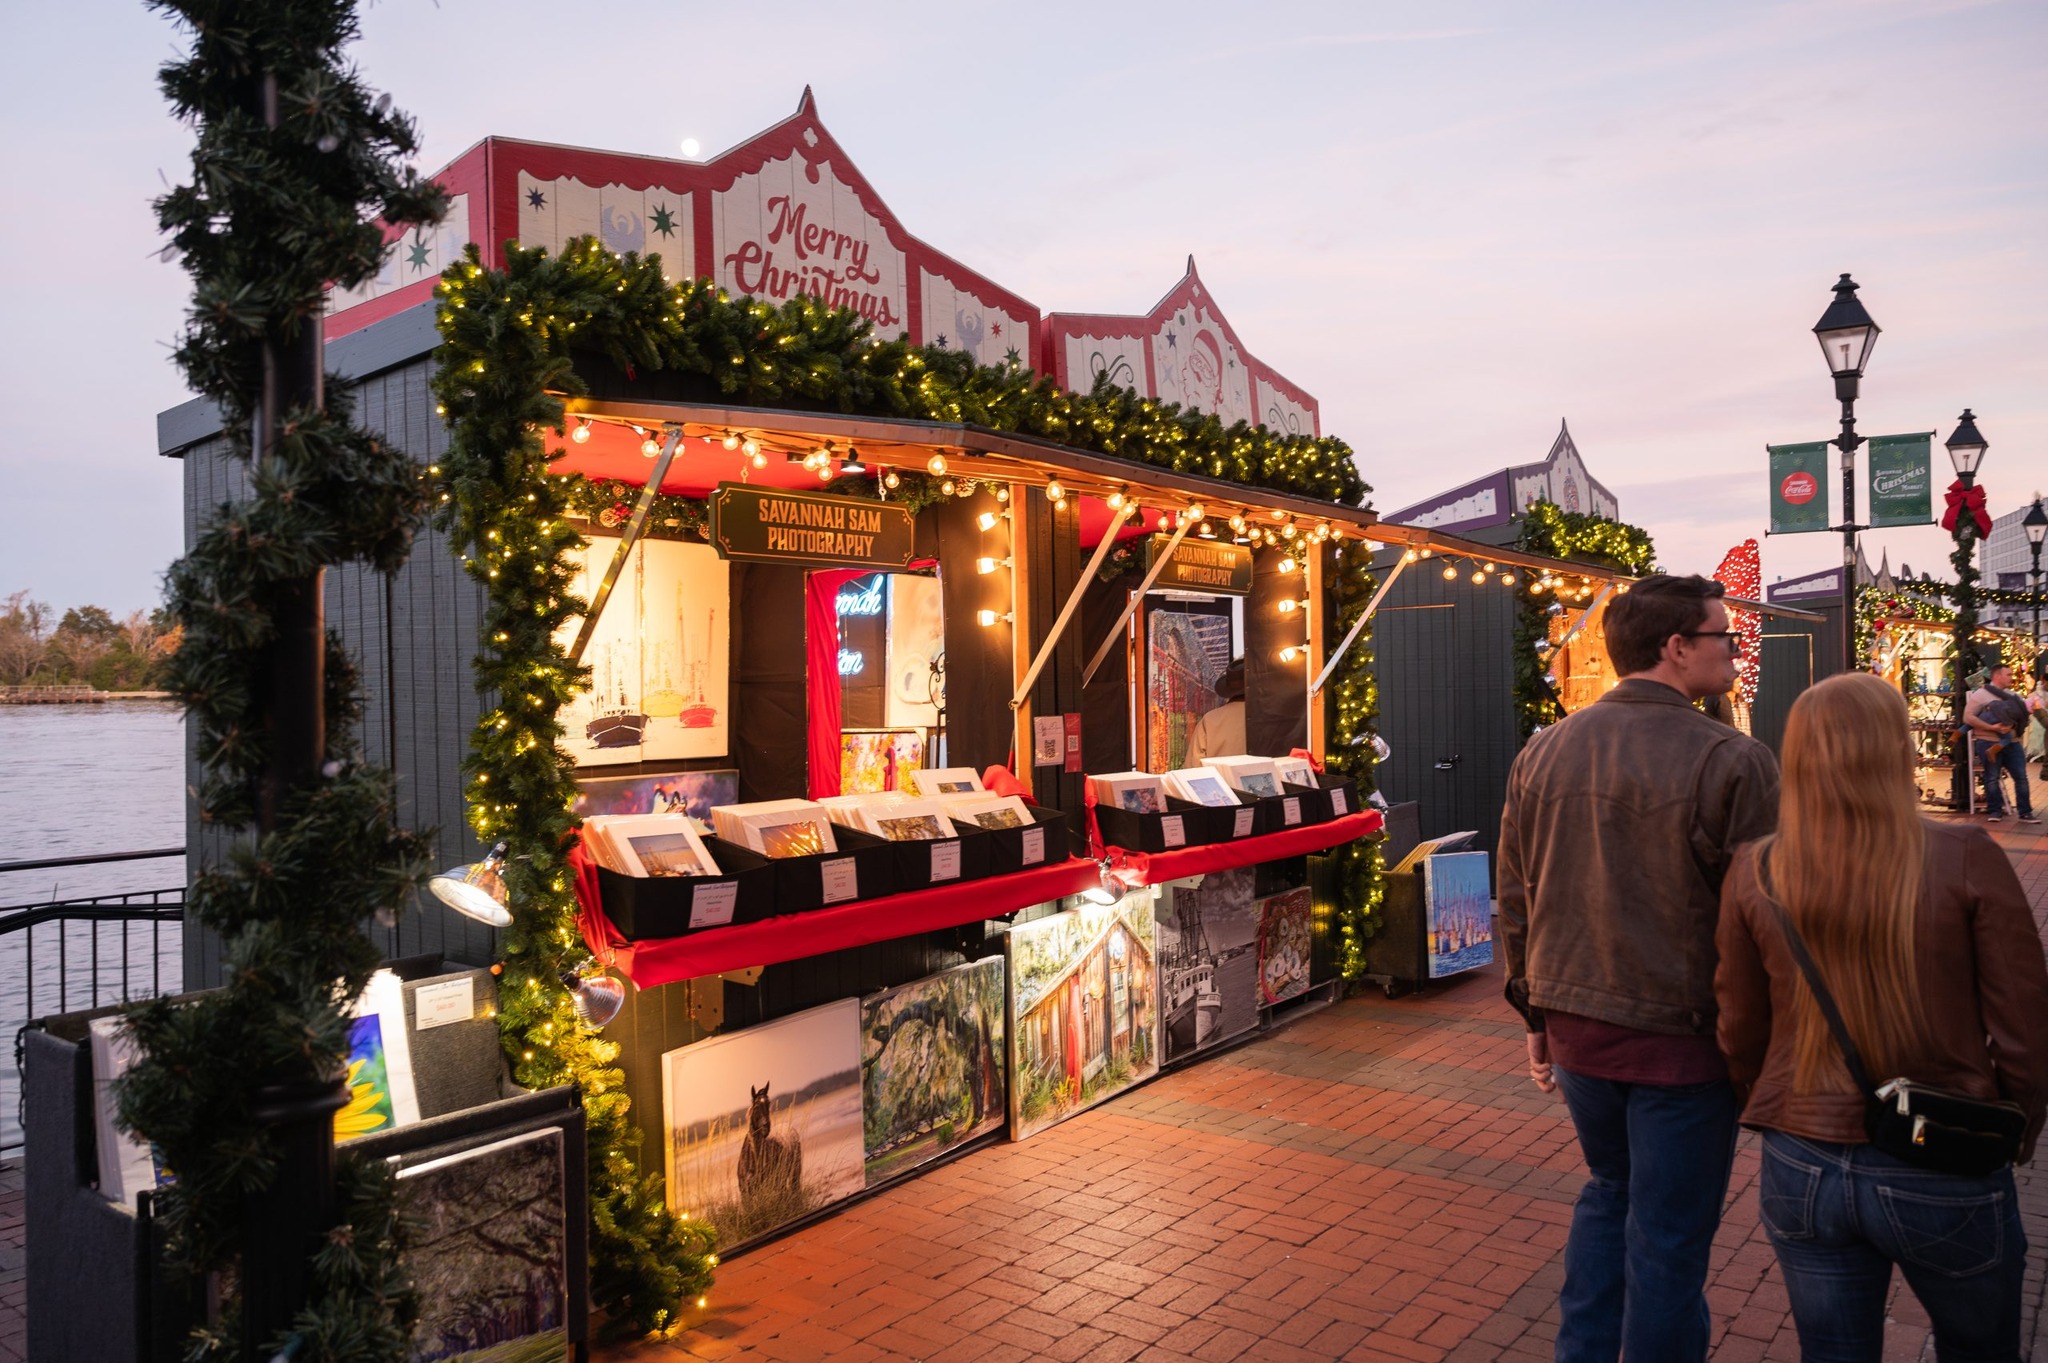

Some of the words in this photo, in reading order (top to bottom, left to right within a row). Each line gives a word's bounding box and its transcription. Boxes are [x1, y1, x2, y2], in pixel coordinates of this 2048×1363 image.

[767, 194, 880, 285] Merry
[724, 240, 899, 327] Christmas
[759, 498, 845, 530] SAVANNAH
[849, 509, 882, 533] SAM
[767, 526, 874, 557] PHOTOGRAPHY
[1172, 545, 1217, 567] SAVANNAH
[1218, 551, 1236, 569] SAM
[1177, 564, 1232, 586] PHOTOGRAPHY
